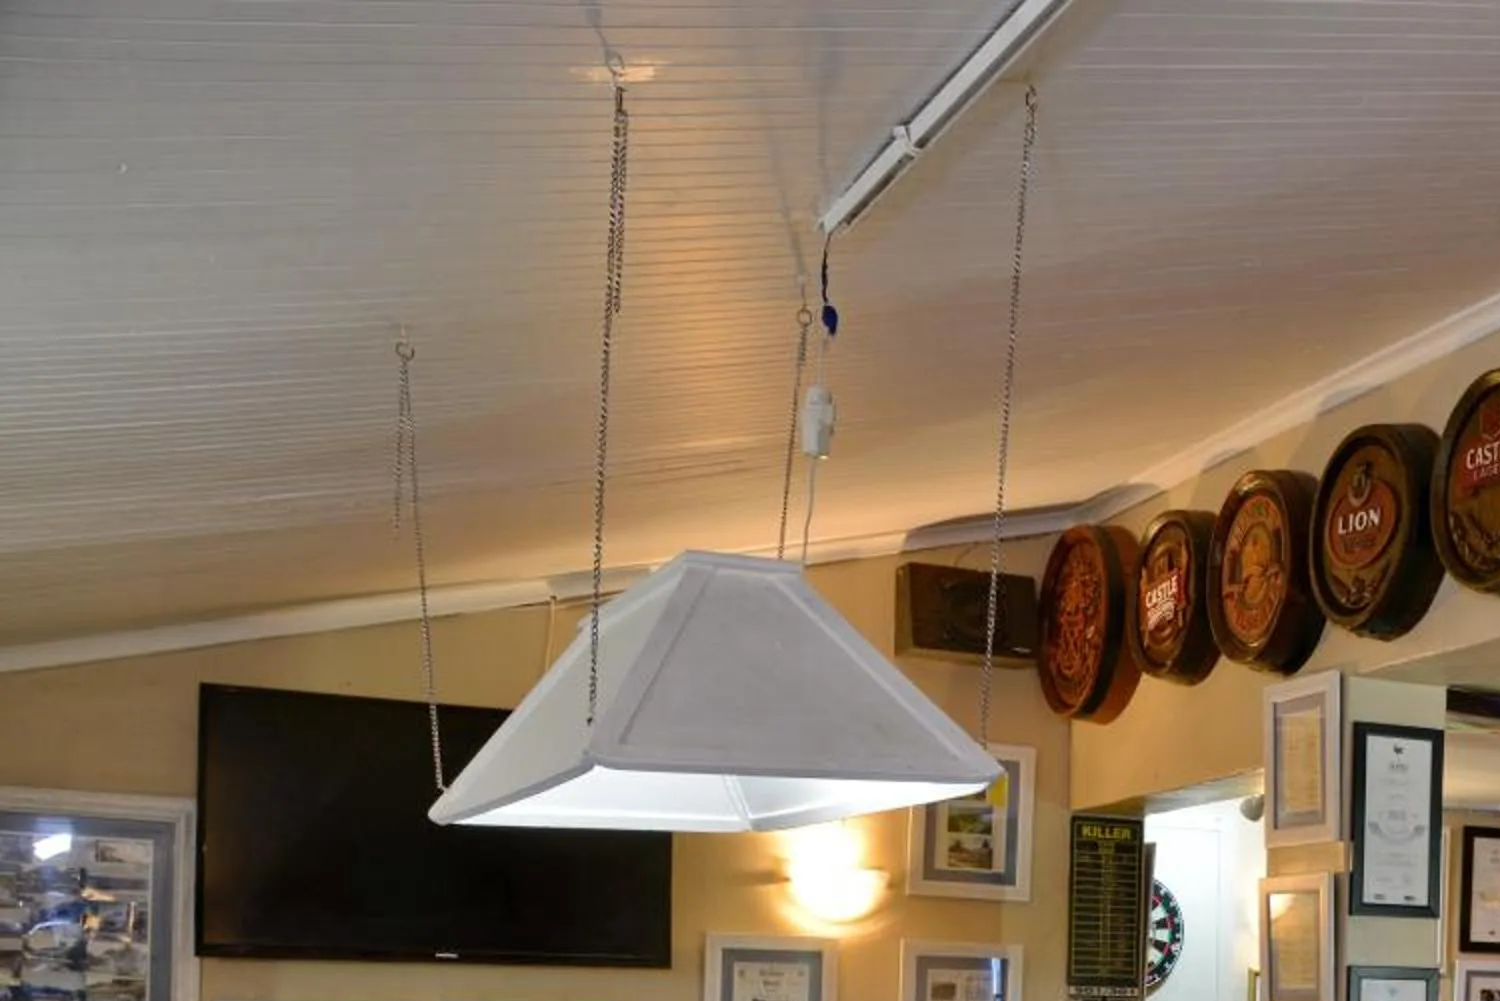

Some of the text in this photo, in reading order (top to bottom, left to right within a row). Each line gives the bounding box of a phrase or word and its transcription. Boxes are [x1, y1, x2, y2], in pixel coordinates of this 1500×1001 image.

[1336, 507, 1381, 536] LION
[1145, 574, 1180, 608] CASTLE
[1081, 825, 1132, 840] KILLER
